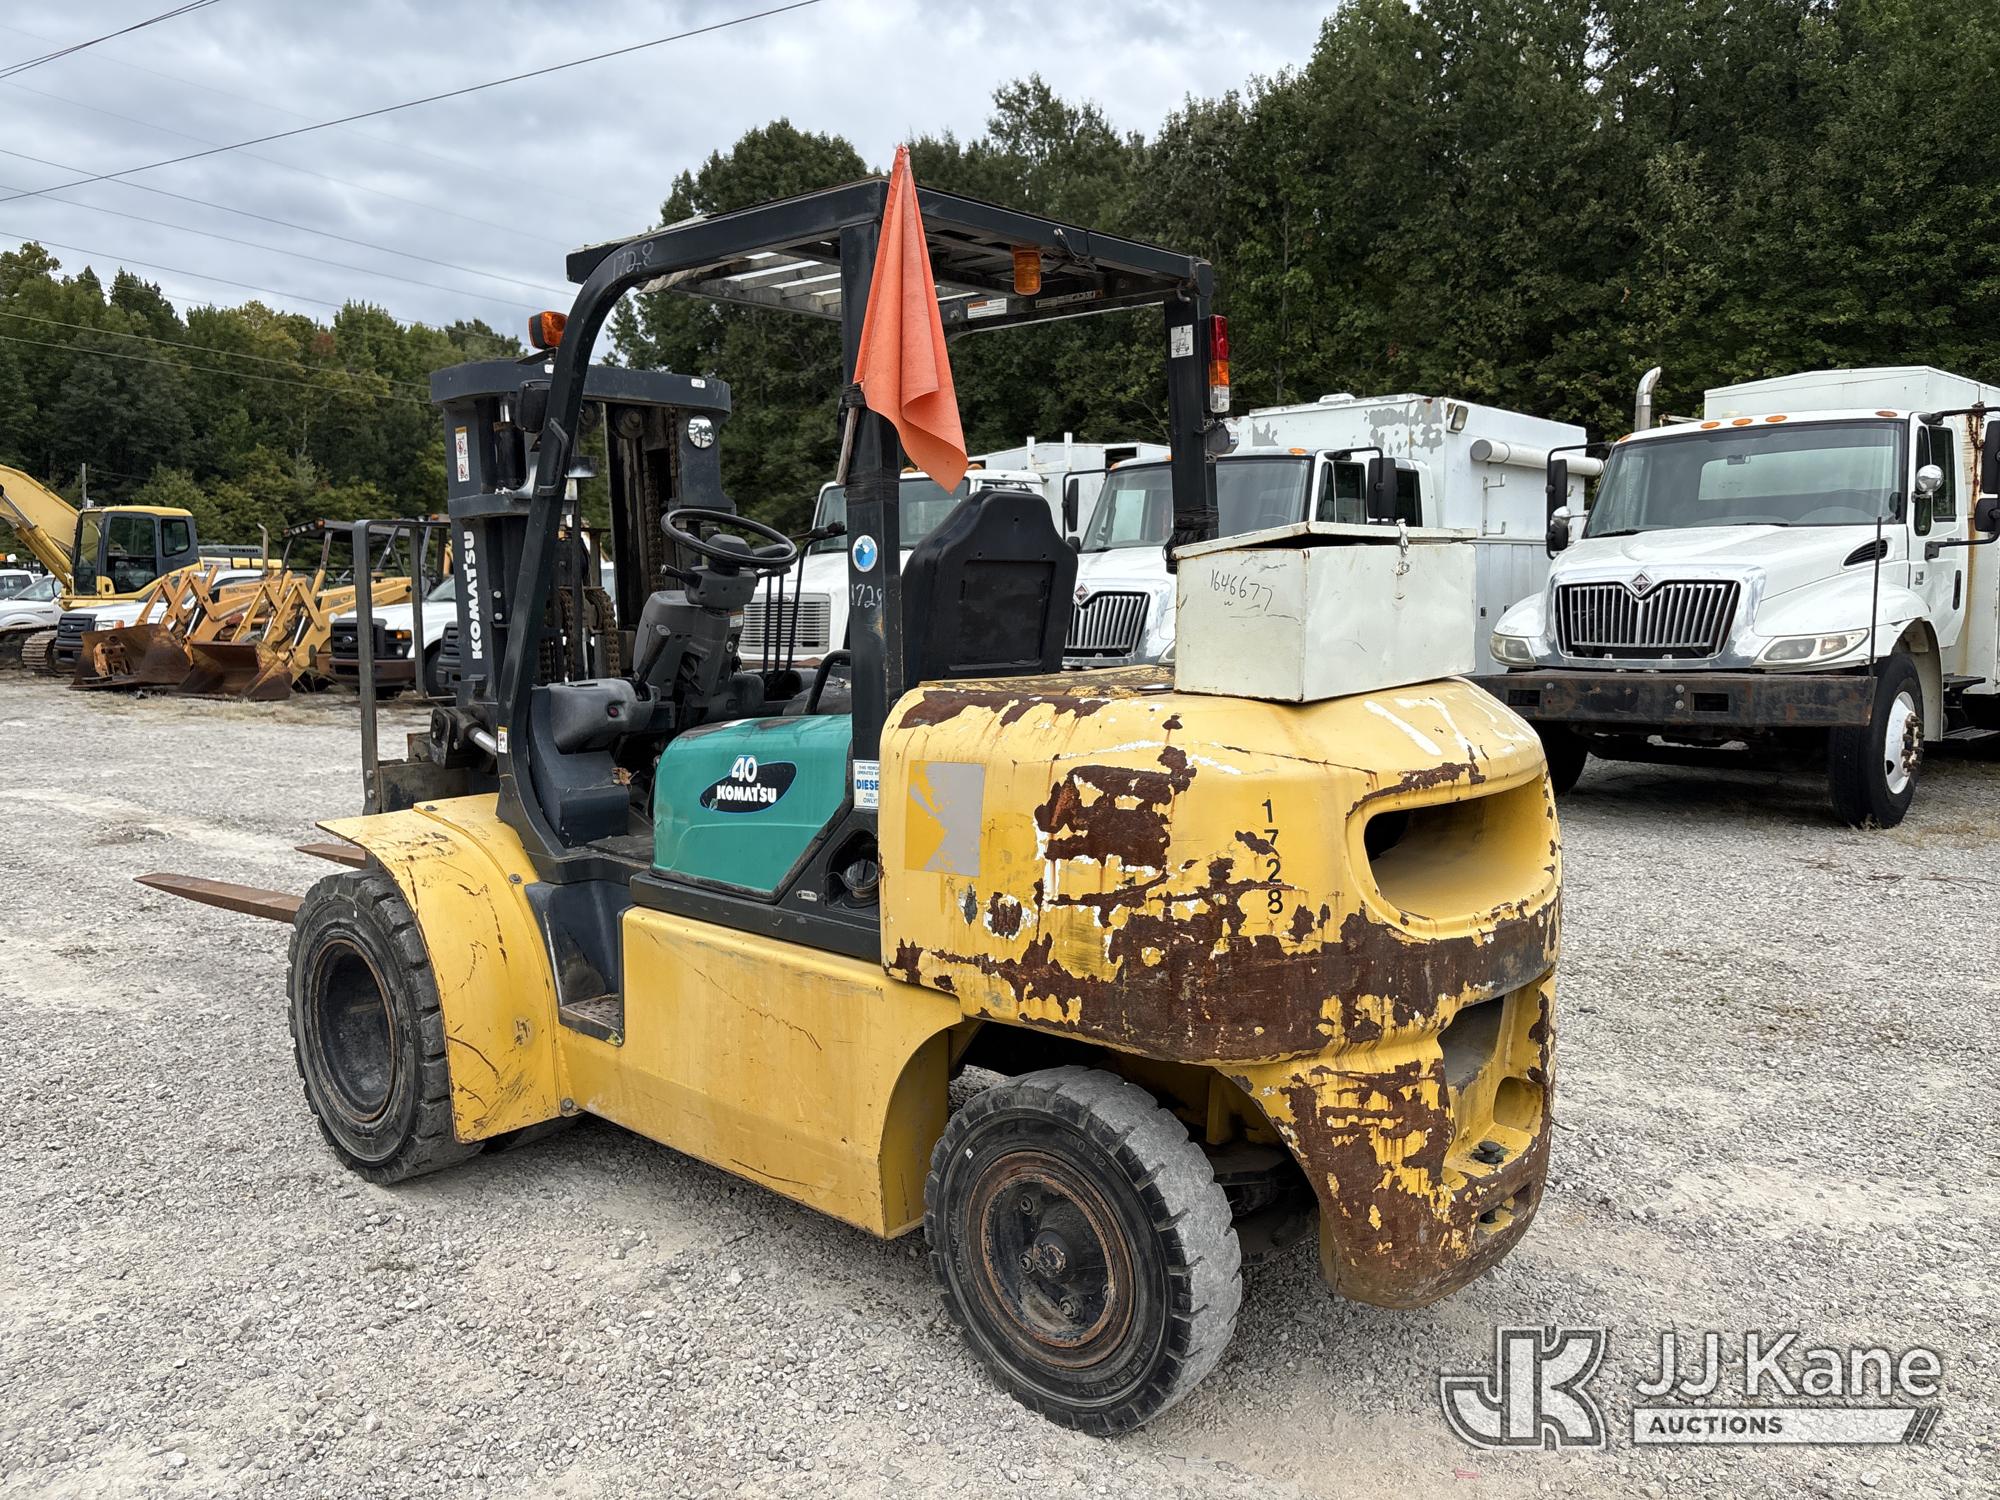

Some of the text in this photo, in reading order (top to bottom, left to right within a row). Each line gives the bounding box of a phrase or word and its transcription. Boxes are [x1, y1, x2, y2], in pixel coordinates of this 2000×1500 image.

[612, 241, 654, 281] 1728
[463, 531, 483, 659] KOMATSU
[1210, 569, 1273, 612] 1646677
[731, 757, 758, 783] 40
[856, 779, 880, 791] DIESE
[716, 783, 777, 803] KOMATSU
